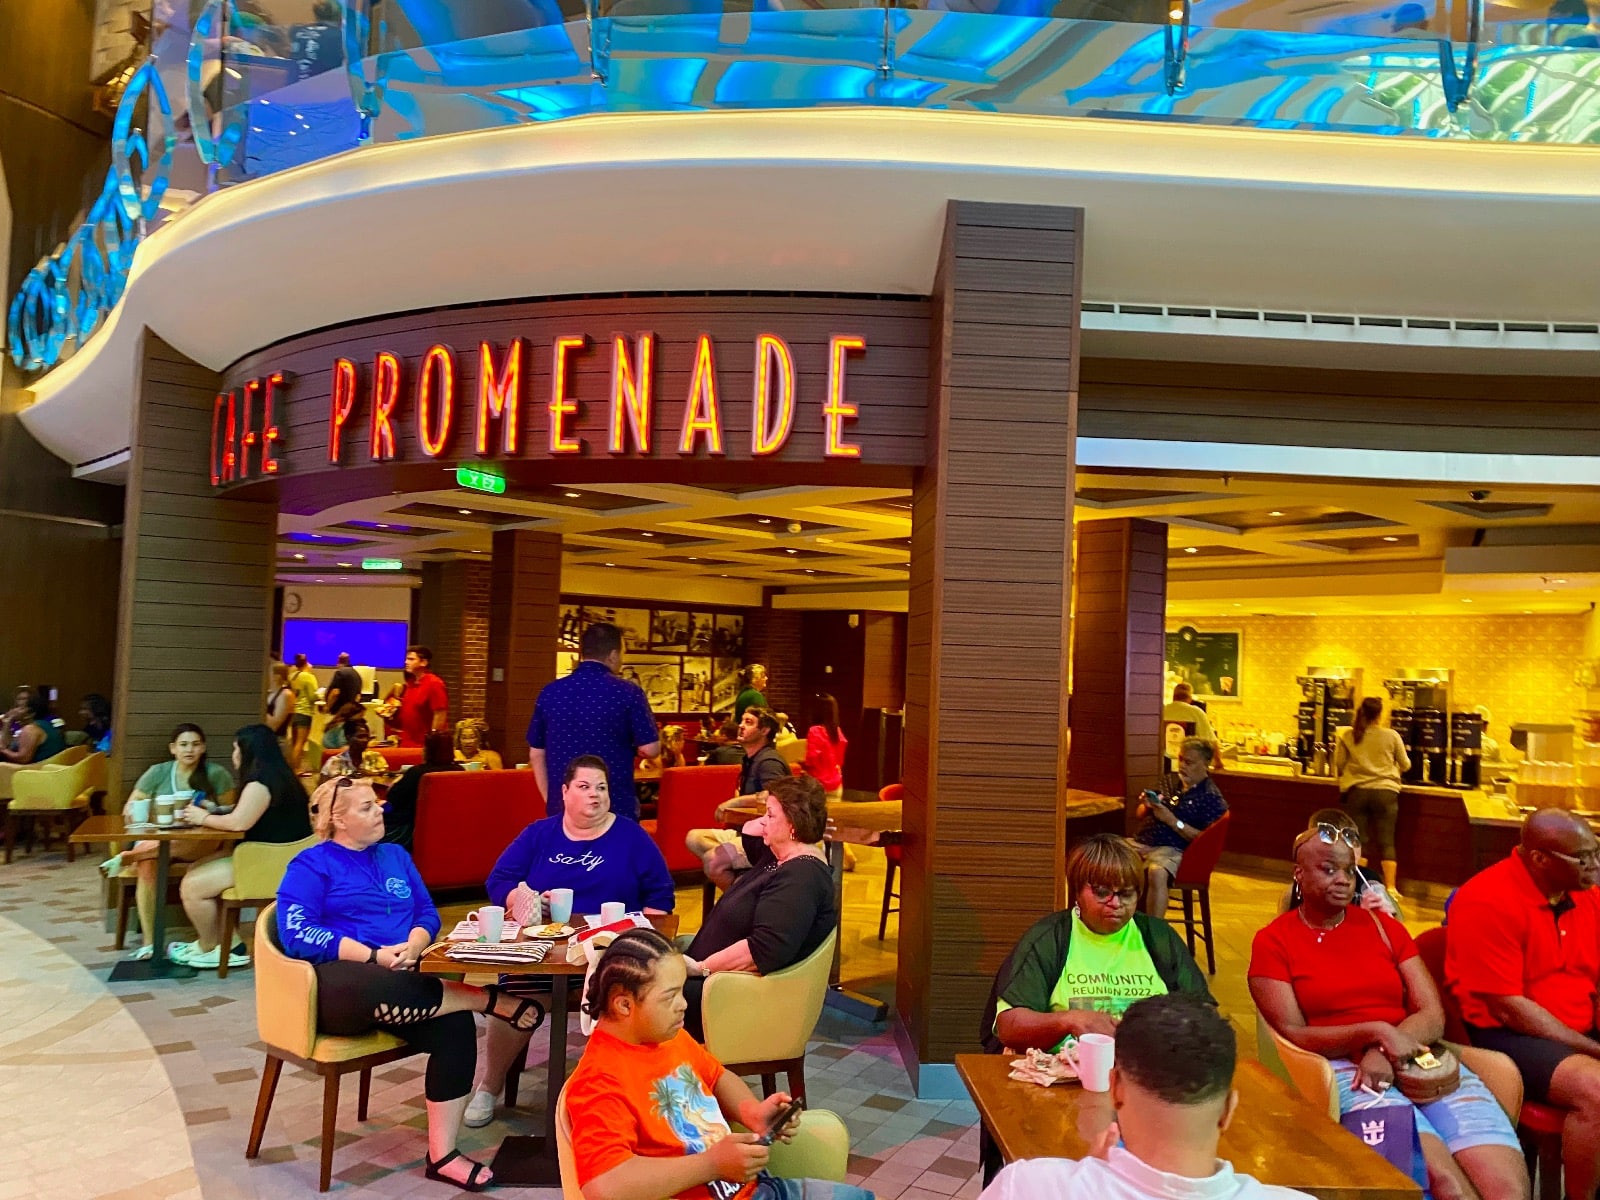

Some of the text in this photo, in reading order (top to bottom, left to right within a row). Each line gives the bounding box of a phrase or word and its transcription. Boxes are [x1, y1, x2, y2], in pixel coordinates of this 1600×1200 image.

[210, 333, 868, 486] CAFE PROMENADE
[1066, 972, 1155, 986] COMMUNITY
[1072, 985, 1153, 997] REUNION 2022
